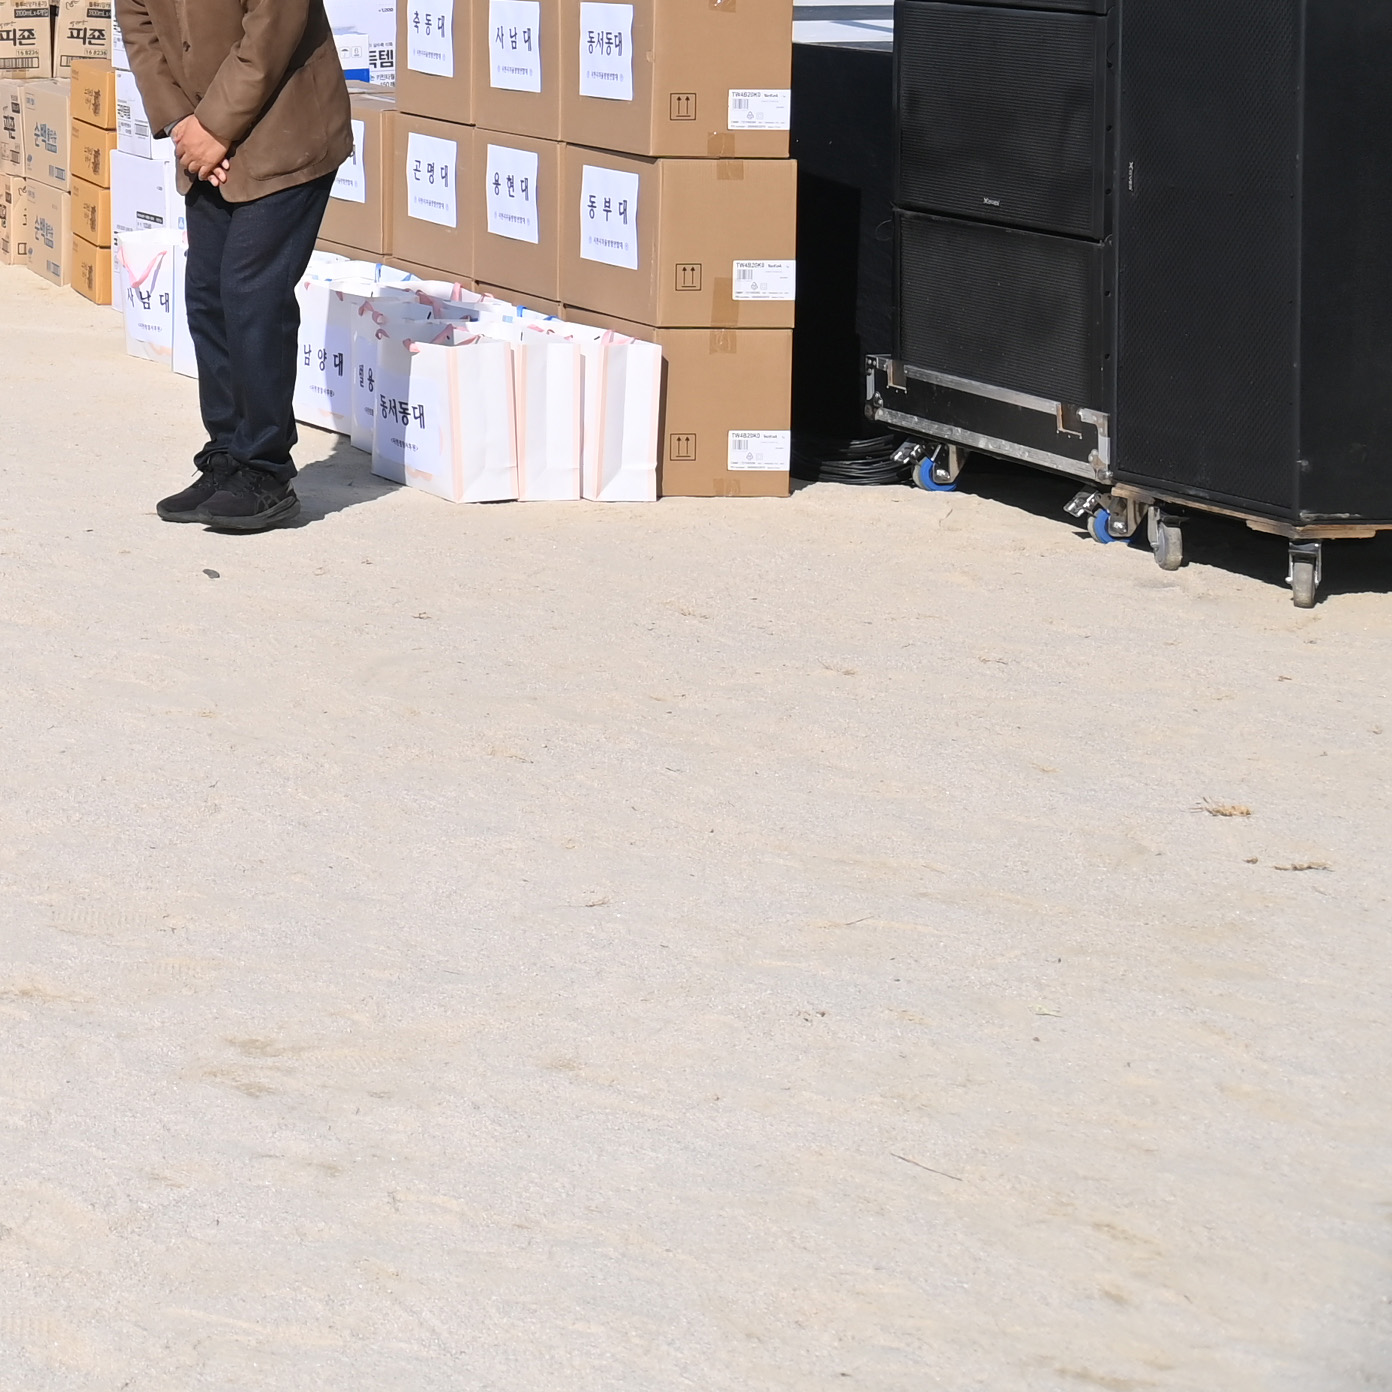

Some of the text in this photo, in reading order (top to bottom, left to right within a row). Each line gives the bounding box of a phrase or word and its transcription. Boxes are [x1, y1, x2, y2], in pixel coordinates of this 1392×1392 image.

[67, 27, 107, 46] 피죤
[412, 10, 446, 39] 축동대
[495, 25, 532, 51] 사남대
[587, 30, 623, 57] 동서동대
[412, 159, 449, 188] 곤명대
[492, 171, 529, 201] 용현대
[587, 194, 628, 225] 동부대
[303, 344, 344, 377] 남양대
[379, 393, 426, 430] 동서동대
